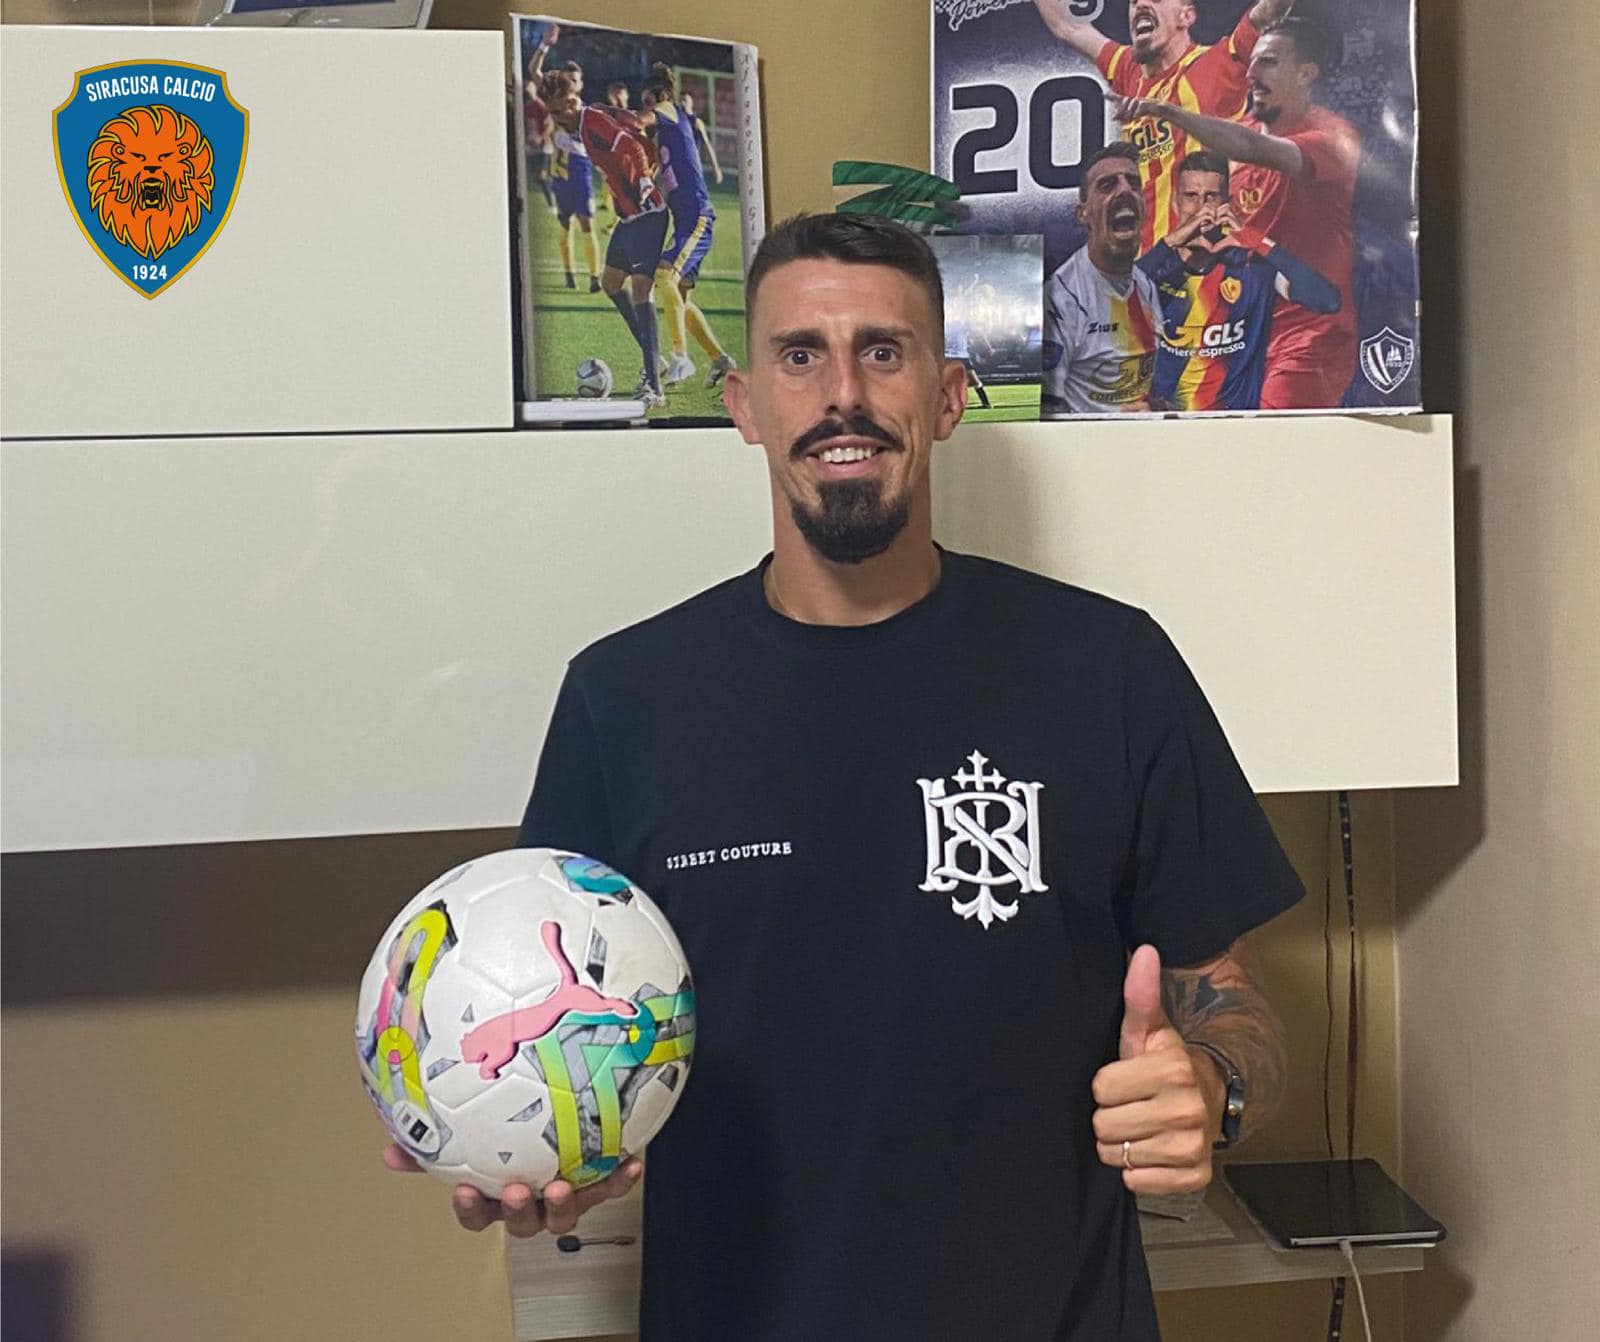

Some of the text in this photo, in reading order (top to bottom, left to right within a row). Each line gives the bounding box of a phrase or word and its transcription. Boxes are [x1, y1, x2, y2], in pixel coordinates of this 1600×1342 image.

[952, 76, 1105, 195] 20
[1129, 117, 1172, 151] GLS
[1203, 318, 1246, 347] GLS
[1198, 341, 1246, 359] espresso
[666, 842, 793, 870] STREET COUTURE
